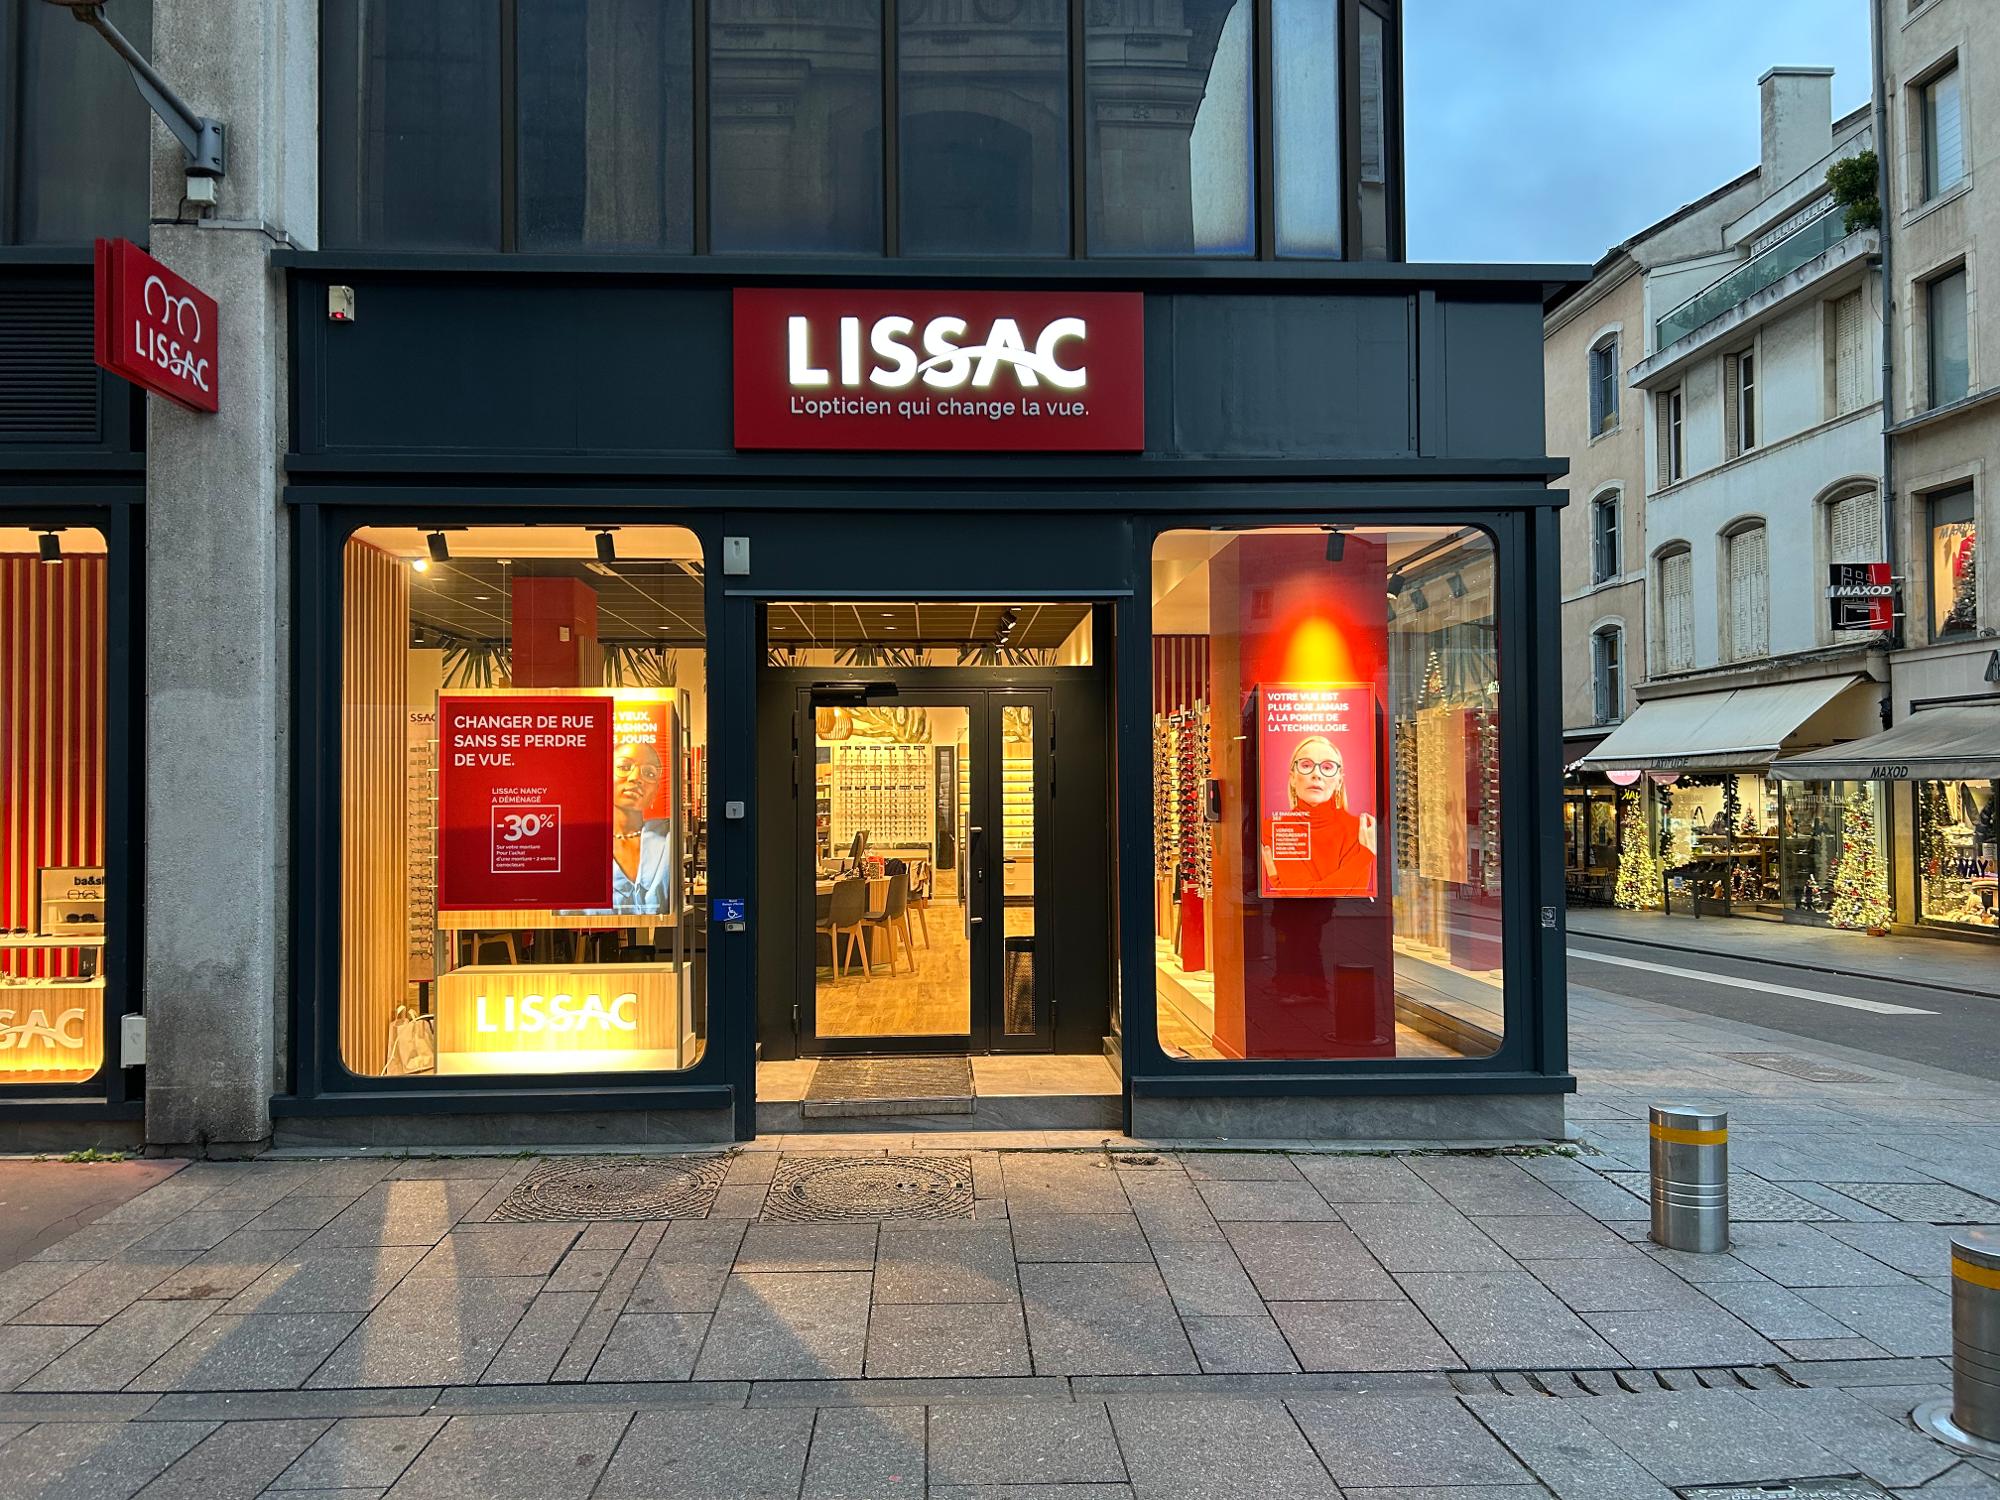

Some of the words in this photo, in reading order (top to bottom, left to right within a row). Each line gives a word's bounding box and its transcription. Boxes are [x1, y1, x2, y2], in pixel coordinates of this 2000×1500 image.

[135, 319, 209, 392] LISSAC
[788, 316, 1087, 388] LISSAC
[790, 397, 891, 418] L'opticien
[898, 398, 930, 419] qui
[937, 397, 1016, 420] change
[1022, 397, 1040, 416] la
[1046, 401, 1090, 416] vue.
[1836, 585, 1893, 596] MAXOD
[1267, 692, 1298, 701] VOTRE
[1267, 703, 1292, 711] PLUS
[1293, 703, 1314, 711] QUE
[1316, 703, 1350, 711] JAMAIS
[453, 715, 533, 729] CHANGER
[536, 715, 558, 729] DE
[561, 715, 594, 729] RUE
[1267, 712, 1275, 721] À
[1276, 713, 1289, 721] LA
[1290, 713, 1323, 721] POINTE
[1326, 713, 1340, 721] DE
[1268, 723, 1281, 732] LA
[453, 734, 498, 748] SANS
[500, 734, 520, 748] SE
[524, 734, 587, 748] PERDRE
[620, 734, 657, 744] JOURS
[453, 753, 476, 767] DE
[478, 753, 515, 767] VUE.
[1870, 766, 1909, 778] MAXOD
[491, 787, 519, 795] LISSAC
[520, 787, 548, 795] NANCY
[498, 795, 542, 804] DÉMÉNAGÉ
[476, 993, 638, 1033] LISSAC
